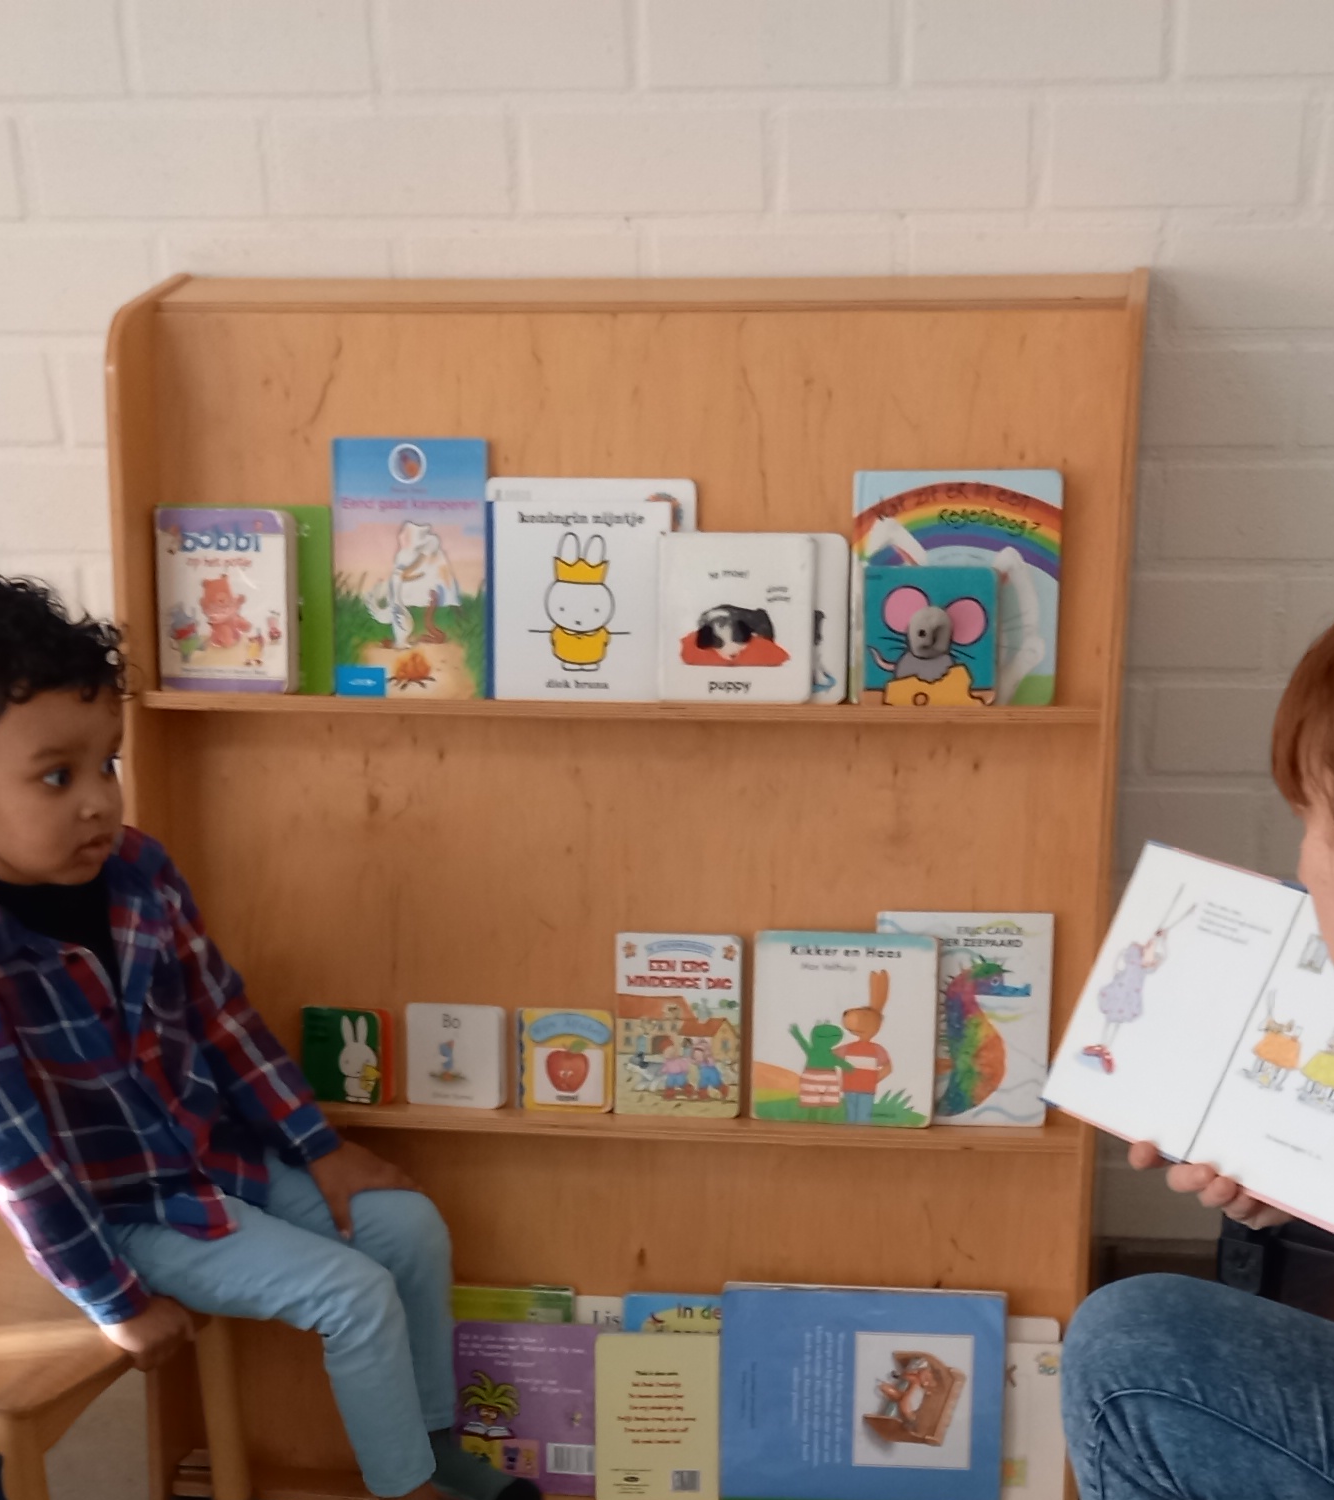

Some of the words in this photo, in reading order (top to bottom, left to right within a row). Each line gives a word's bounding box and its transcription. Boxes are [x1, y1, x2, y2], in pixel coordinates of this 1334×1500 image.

[518, 511, 588, 526] koningin
[592, 511, 645, 527] nijntje
[708, 680, 751, 693] puppy
[963, 938, 1023, 948] ZEEPAARD
[790, 945, 838, 956] Kikker
[843, 948, 861, 957] en
[865, 947, 902, 959] Haas
[649, 960, 676, 972] EEN
[706, 977, 733, 990] DAG
[442, 1013, 461, 1029] Bo
